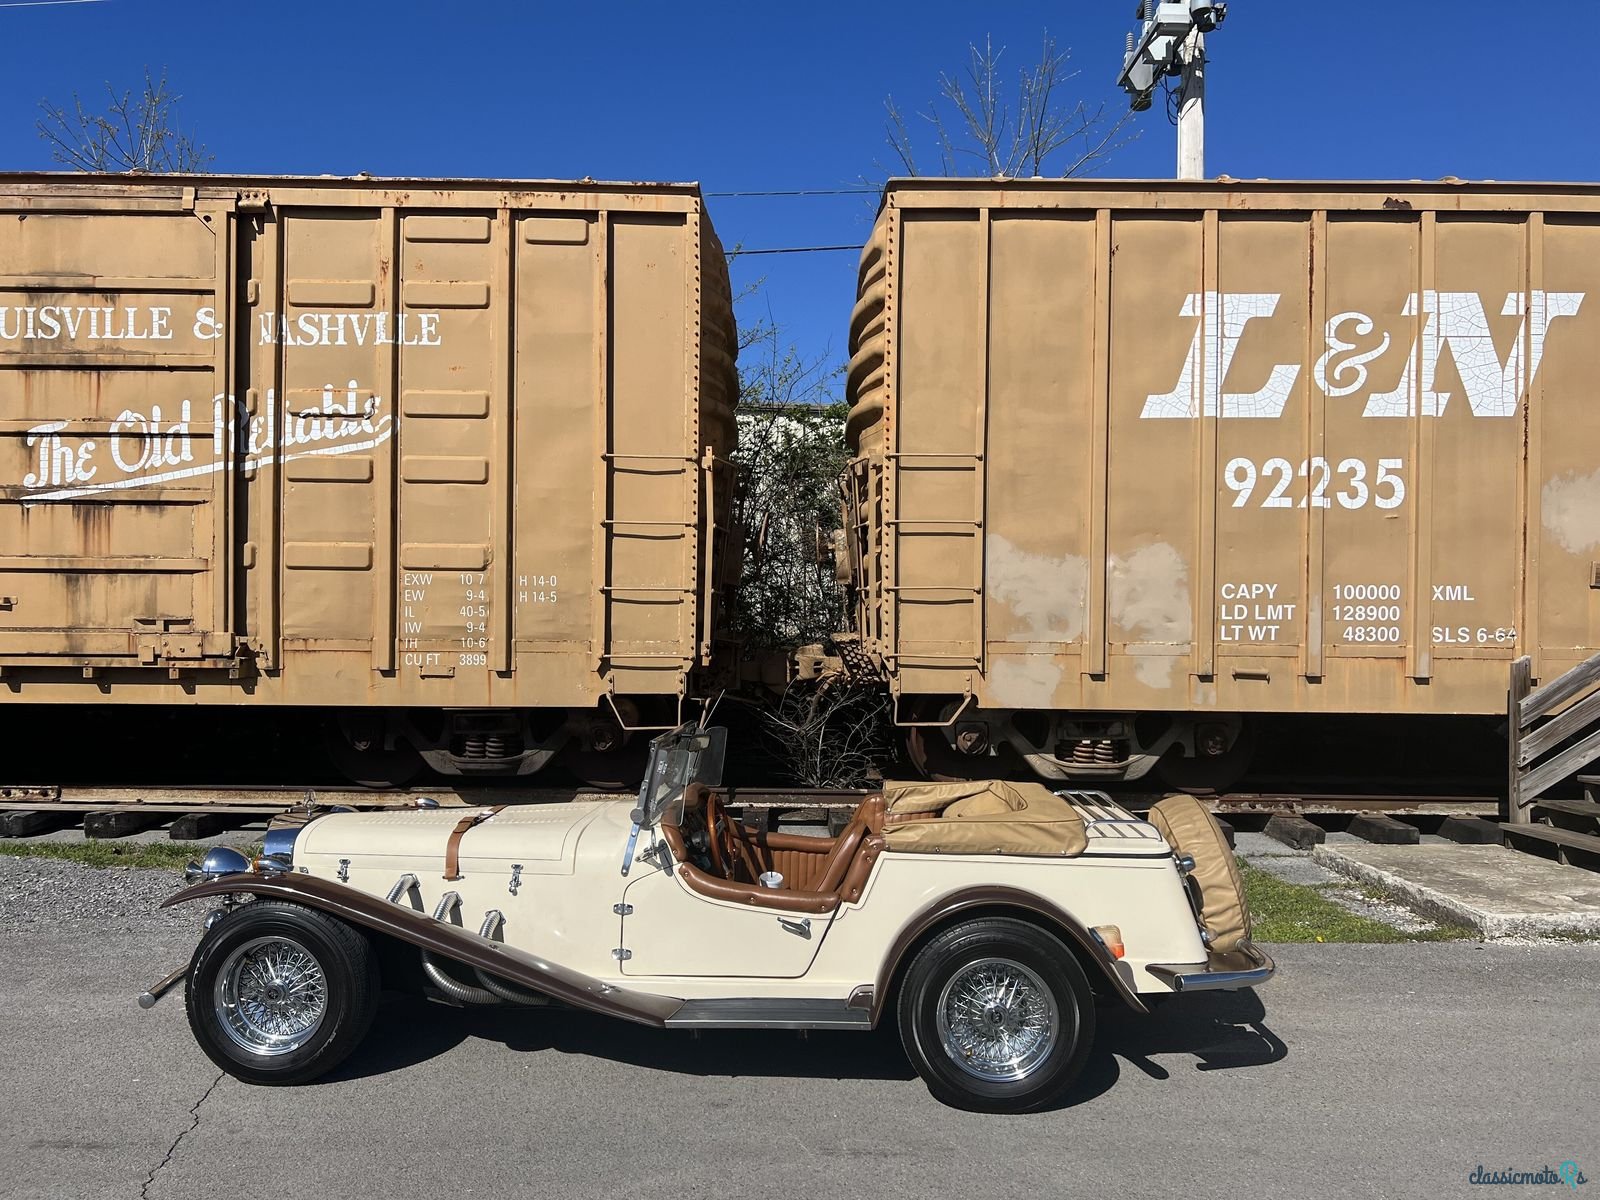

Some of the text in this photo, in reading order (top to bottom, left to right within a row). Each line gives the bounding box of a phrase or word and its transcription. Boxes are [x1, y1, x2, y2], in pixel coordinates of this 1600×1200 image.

[193, 307, 224, 340] &
[258, 311, 442, 346] NASHVILLE
[23, 380, 386, 489] The Old Reliable
[1224, 457, 1406, 510] 92235
[404, 574, 432, 585] EXW
[519, 575, 557, 587] H 14-0
[404, 590, 485, 601] EW 9-4
[519, 591, 557, 603] H 14-5
[1220, 583, 1400, 600] CAPY 100000
[1431, 585, 1475, 601] XML
[404, 606, 485, 618] IL 40-5
[1220, 604, 1400, 621] LD LMT 128900
[404, 622, 486, 633] IW 9-4
[1220, 625, 1400, 642] LT WT 48300
[1431, 627, 1518, 643] SLS 6-64
[405, 638, 486, 649] IH 10-6
[405, 654, 487, 666] CU FT 3899
